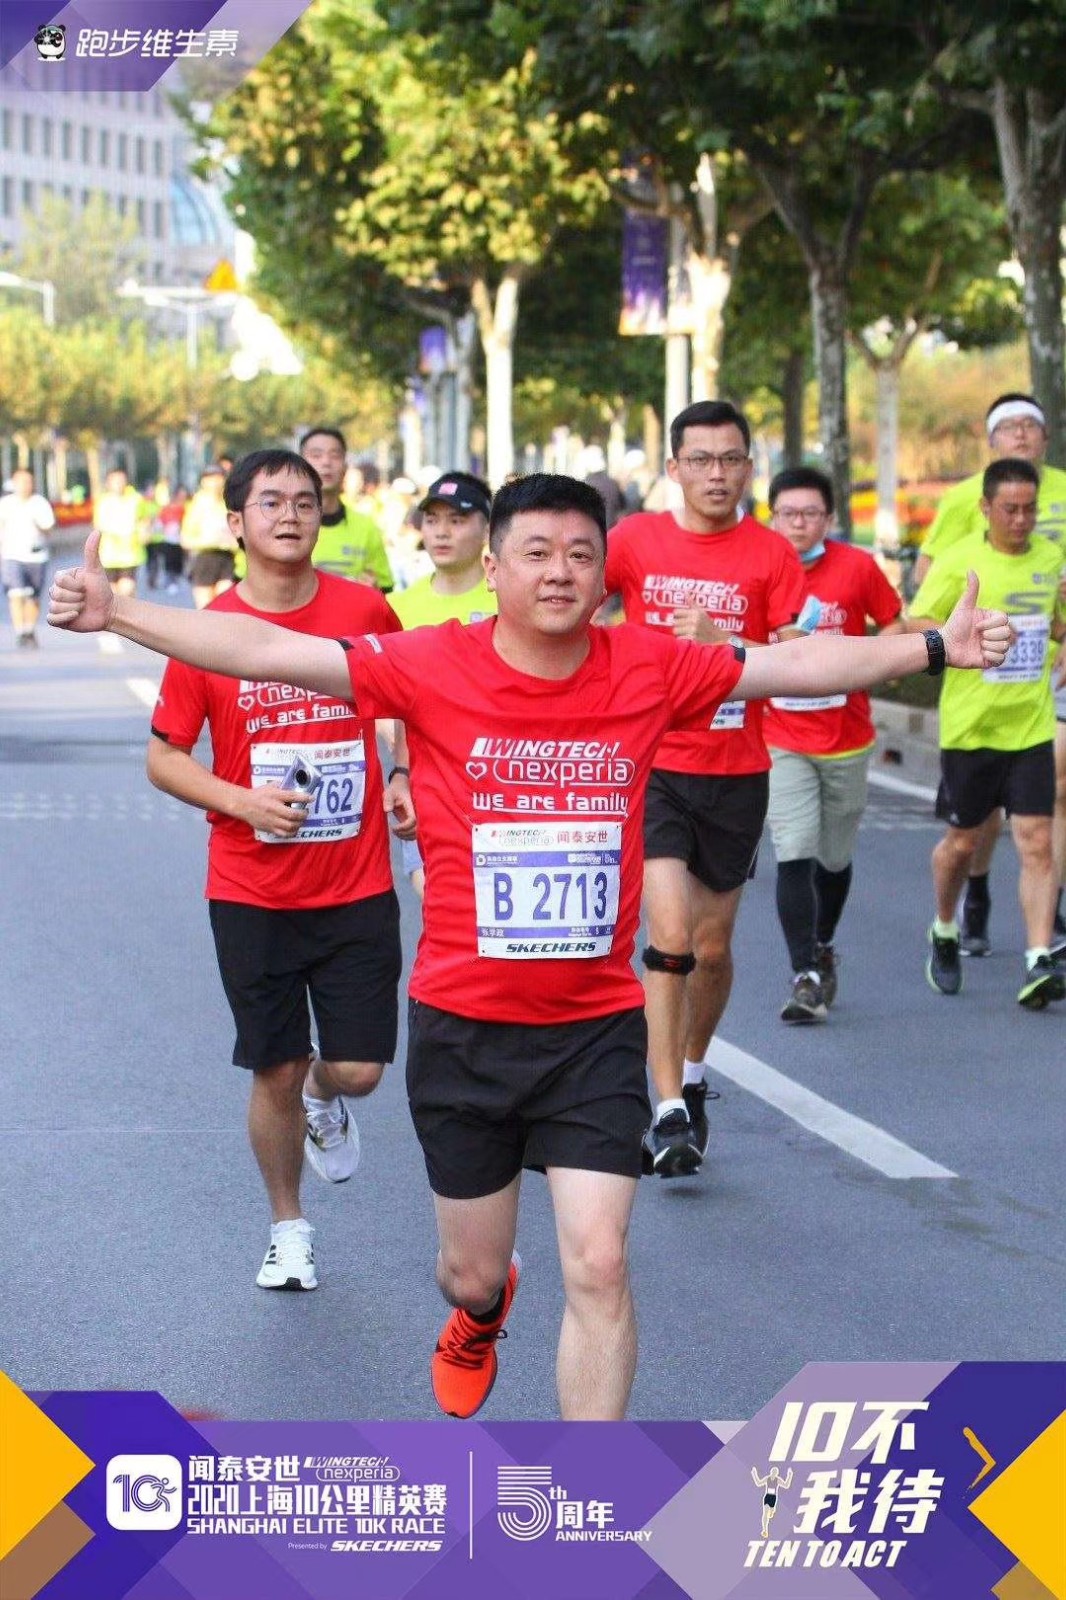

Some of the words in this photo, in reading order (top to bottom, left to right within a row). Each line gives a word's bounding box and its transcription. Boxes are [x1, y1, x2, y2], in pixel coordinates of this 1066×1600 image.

[661, 590, 742, 611] neperia
[277, 708, 306, 723] are
[470, 737, 620, 759] WINGTECH
[508, 758, 628, 788] nexperia
[516, 794, 555, 811] are
[565, 791, 630, 815] family
[297, 828, 343, 839] CHERS
[557, 830, 608, 844] 闻泰安世
[493, 872, 514, 921] B
[532, 871, 609, 921] 2713
[506, 942, 596, 953] SKECHERS
